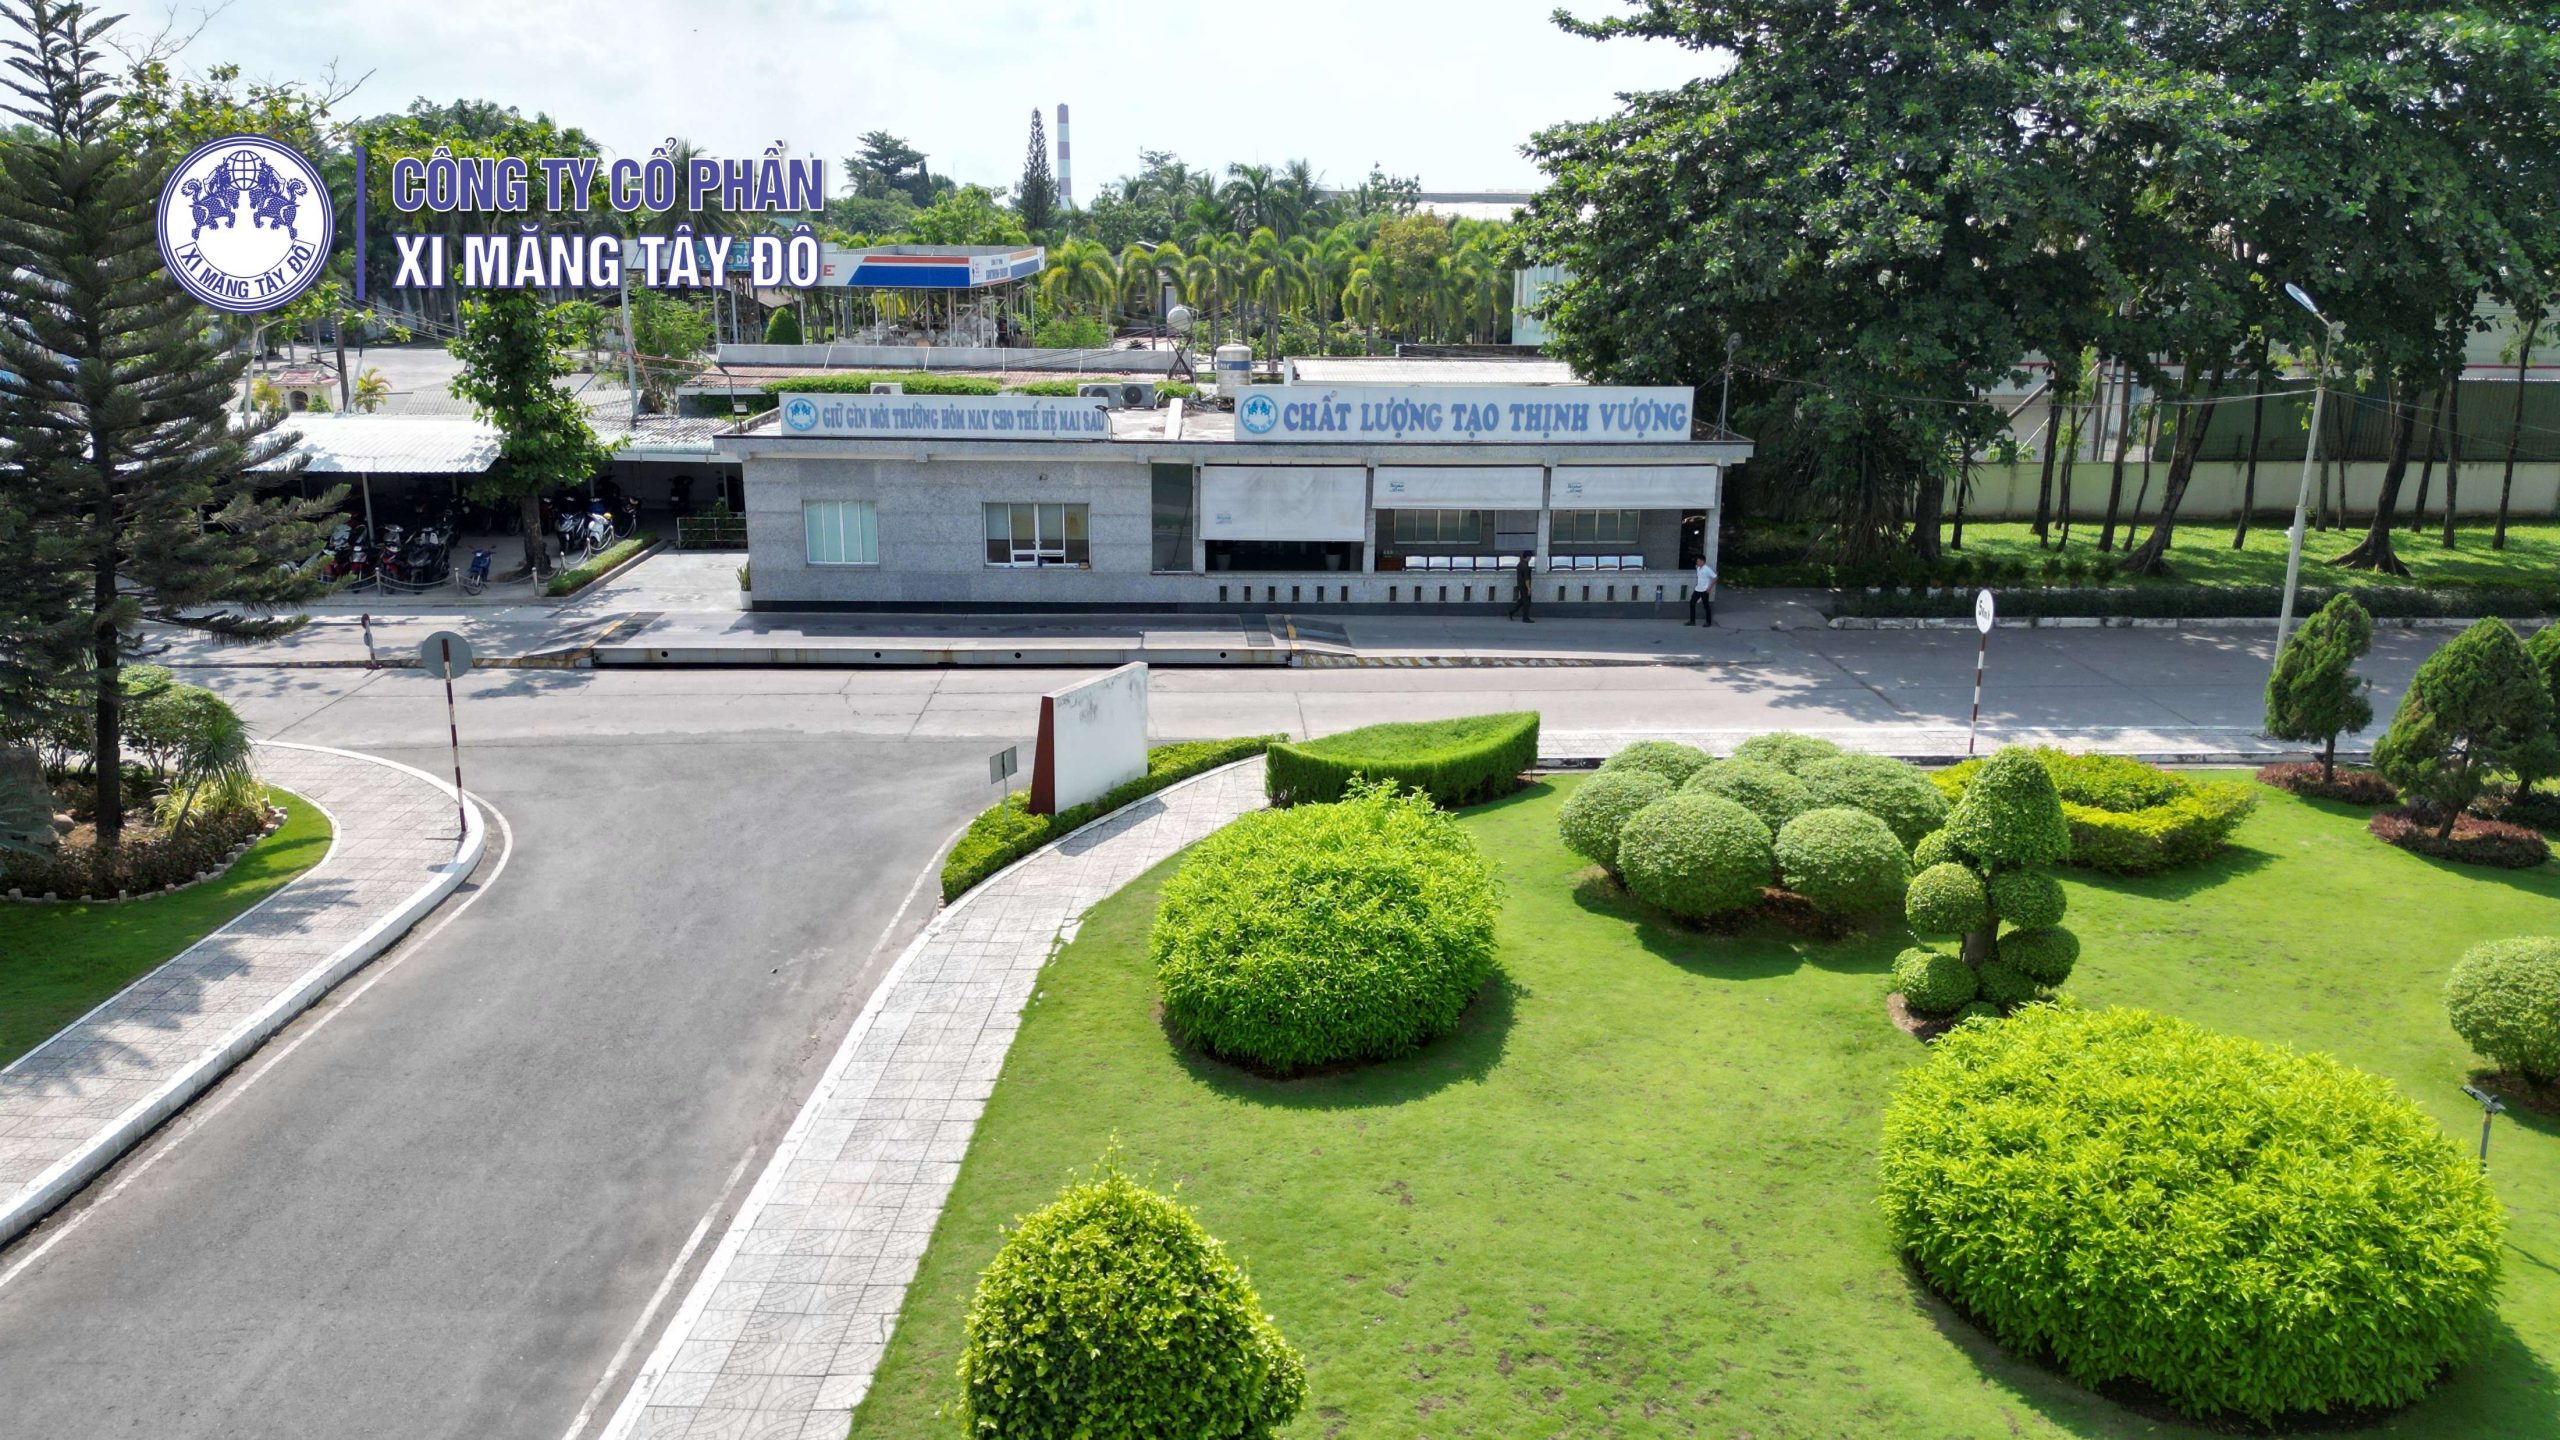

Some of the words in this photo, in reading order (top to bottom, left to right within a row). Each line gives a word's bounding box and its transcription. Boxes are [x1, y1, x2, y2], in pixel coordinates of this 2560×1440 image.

[822, 402, 844, 428] GIỮ
[846, 403, 867, 429] GÌN
[869, 403, 890, 429] MÔI
[892, 402, 939, 430] TRƯỜNG
[941, 403, 965, 430] HÔM
[968, 409, 990, 430] NAY
[992, 409, 1015, 431] CHO
[1016, 400, 1040, 430] THẾ
[1041, 405, 1057, 436] HỆ
[1059, 409, 1081, 431] MAI
[1083, 409, 1105, 432] SAU
[1283, 390, 1351, 431] CHẤT
[1360, 397, 1443, 438] LƯỢNG
[1451, 403, 1499, 438] TẠO
[1509, 403, 1590, 438] THỊNH
[1599, 396, 1687, 438] VƯỢNG
